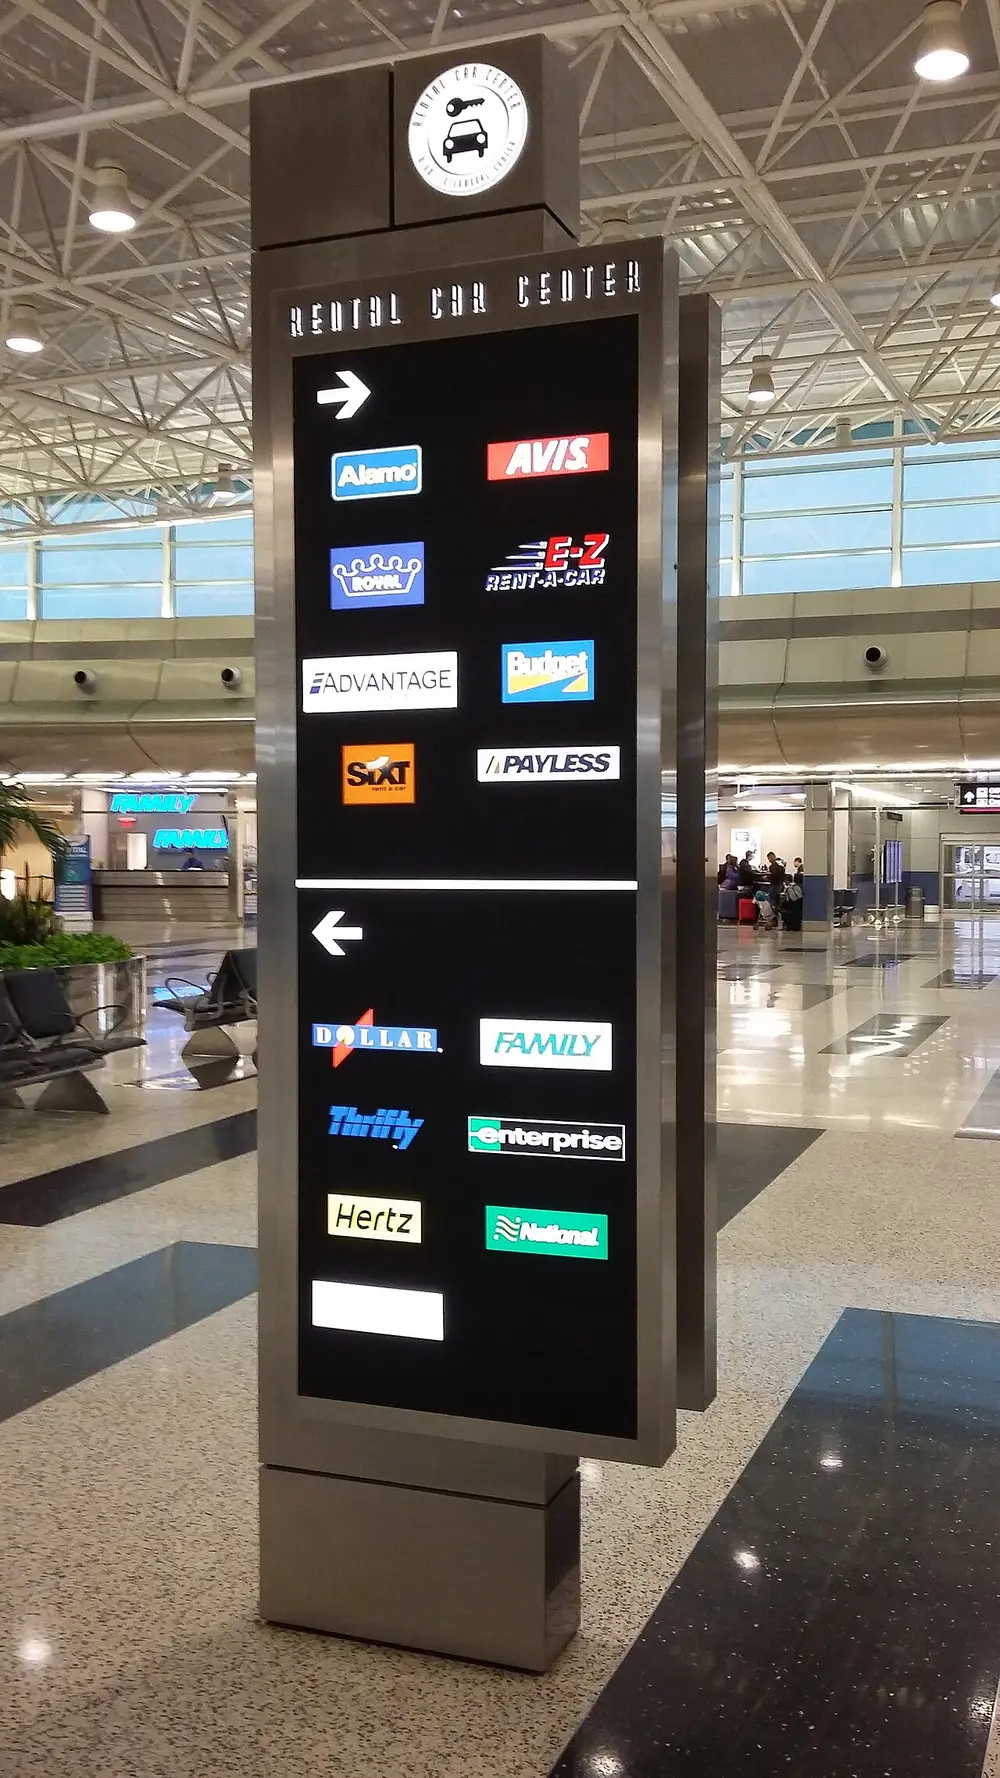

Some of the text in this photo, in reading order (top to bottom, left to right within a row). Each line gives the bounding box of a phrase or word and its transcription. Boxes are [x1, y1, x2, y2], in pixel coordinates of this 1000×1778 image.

[455, 66, 478, 81] CAR
[289, 259, 642, 338] RENTAL CAR CENTER
[505, 436, 591, 476] AVIS
[337, 463, 417, 488] Alamo
[543, 532, 610, 571] E-Z
[351, 574, 403, 592] ROYAL
[485, 568, 606, 592] RENT-A-CAR
[507, 649, 589, 676] Budget
[322, 669, 452, 694] ADVANTAGE
[503, 752, 611, 775] PAYLESS
[110, 793, 197, 813] FAMILY
[315, 1024, 434, 1050] DOLLAR
[494, 1031, 602, 1057] FAMILY
[328, 1104, 425, 1150] Thrifty
[480, 1125, 623, 1153] enterprise
[336, 1203, 413, 1234] Hertz
[519, 1222, 600, 1247] National
